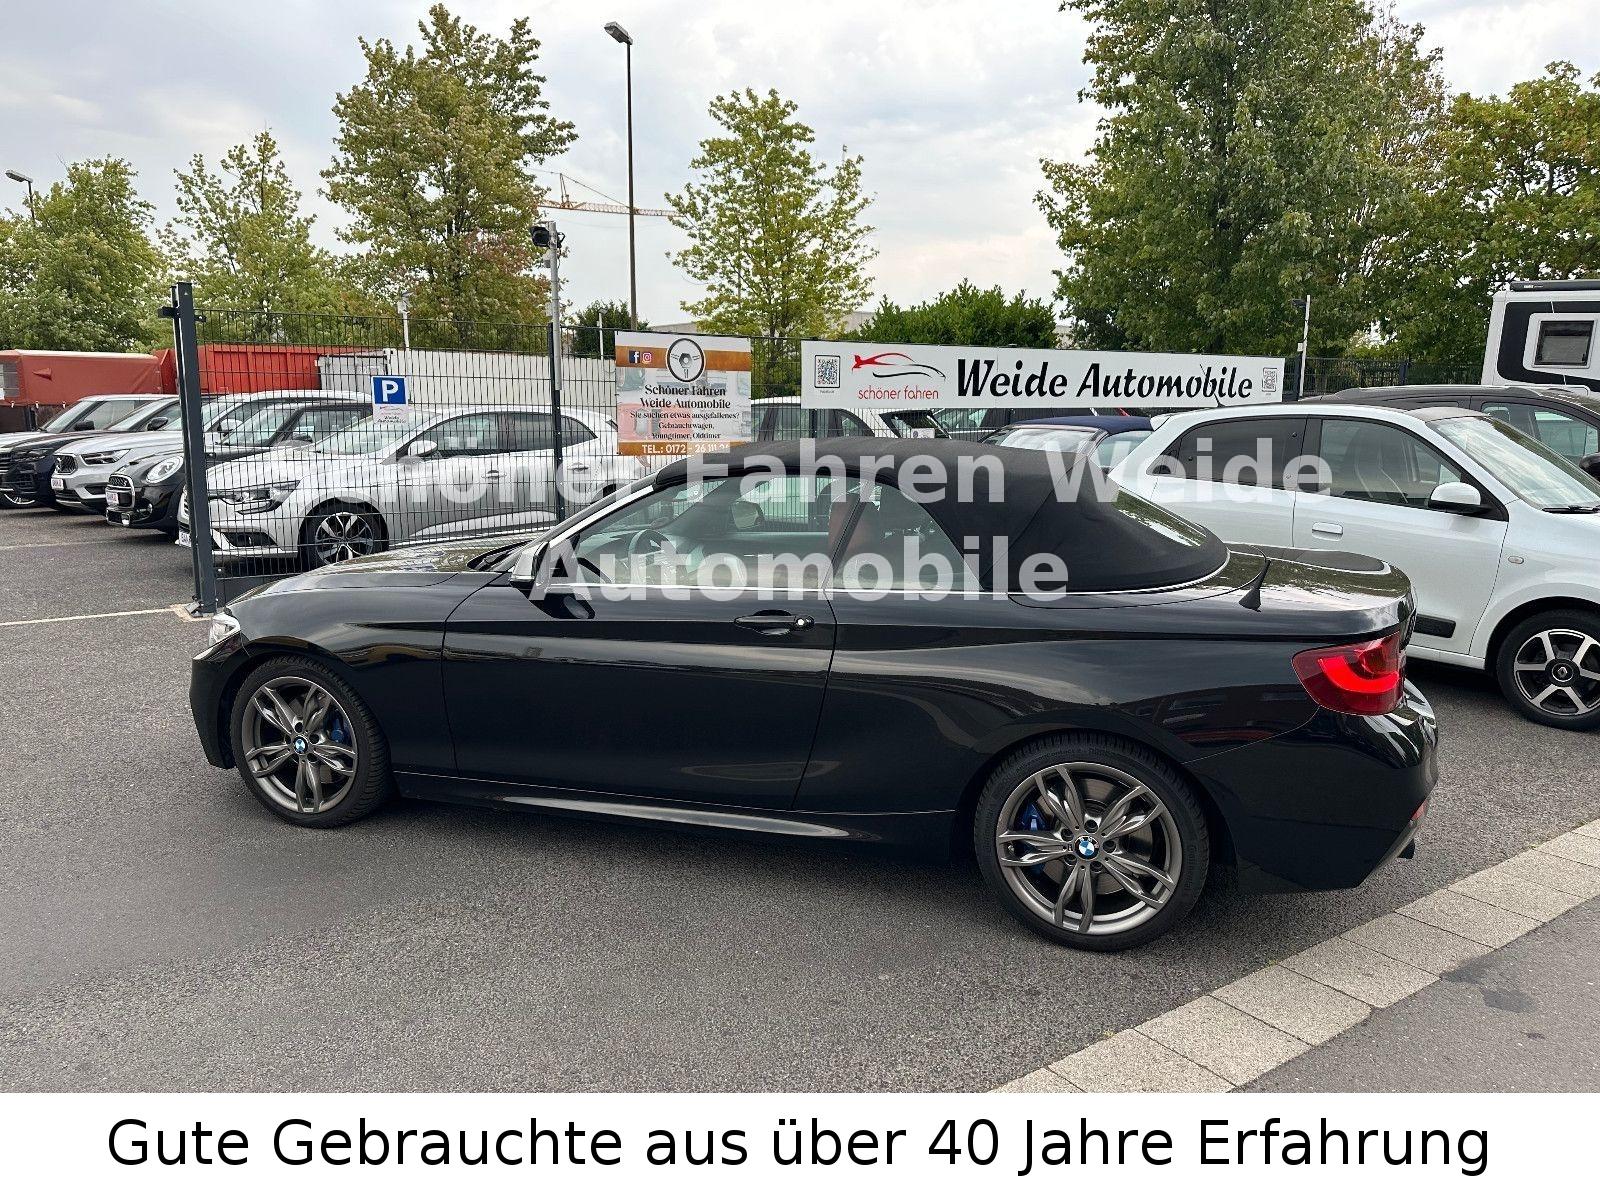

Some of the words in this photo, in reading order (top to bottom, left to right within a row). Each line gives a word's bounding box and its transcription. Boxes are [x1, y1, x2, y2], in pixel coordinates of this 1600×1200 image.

[957, 358, 1068, 398] Weide
[1076, 363, 1253, 399] Automobile
[381, 380, 399, 402] P
[644, 384, 690, 396] Schöner
[692, 385, 726, 397] Fahren
[858, 385, 901, 400] schöner
[904, 385, 939, 400] fahren
[640, 398, 672, 408] Weide
[674, 398, 731, 409] Automobile
[630, 411, 642, 419] Sie
[643, 411, 669, 419] suchen
[691, 411, 740, 421] ausgefallenes?
[642, 444, 664, 454] TEL.:
[665, 444, 687, 454] 0172
